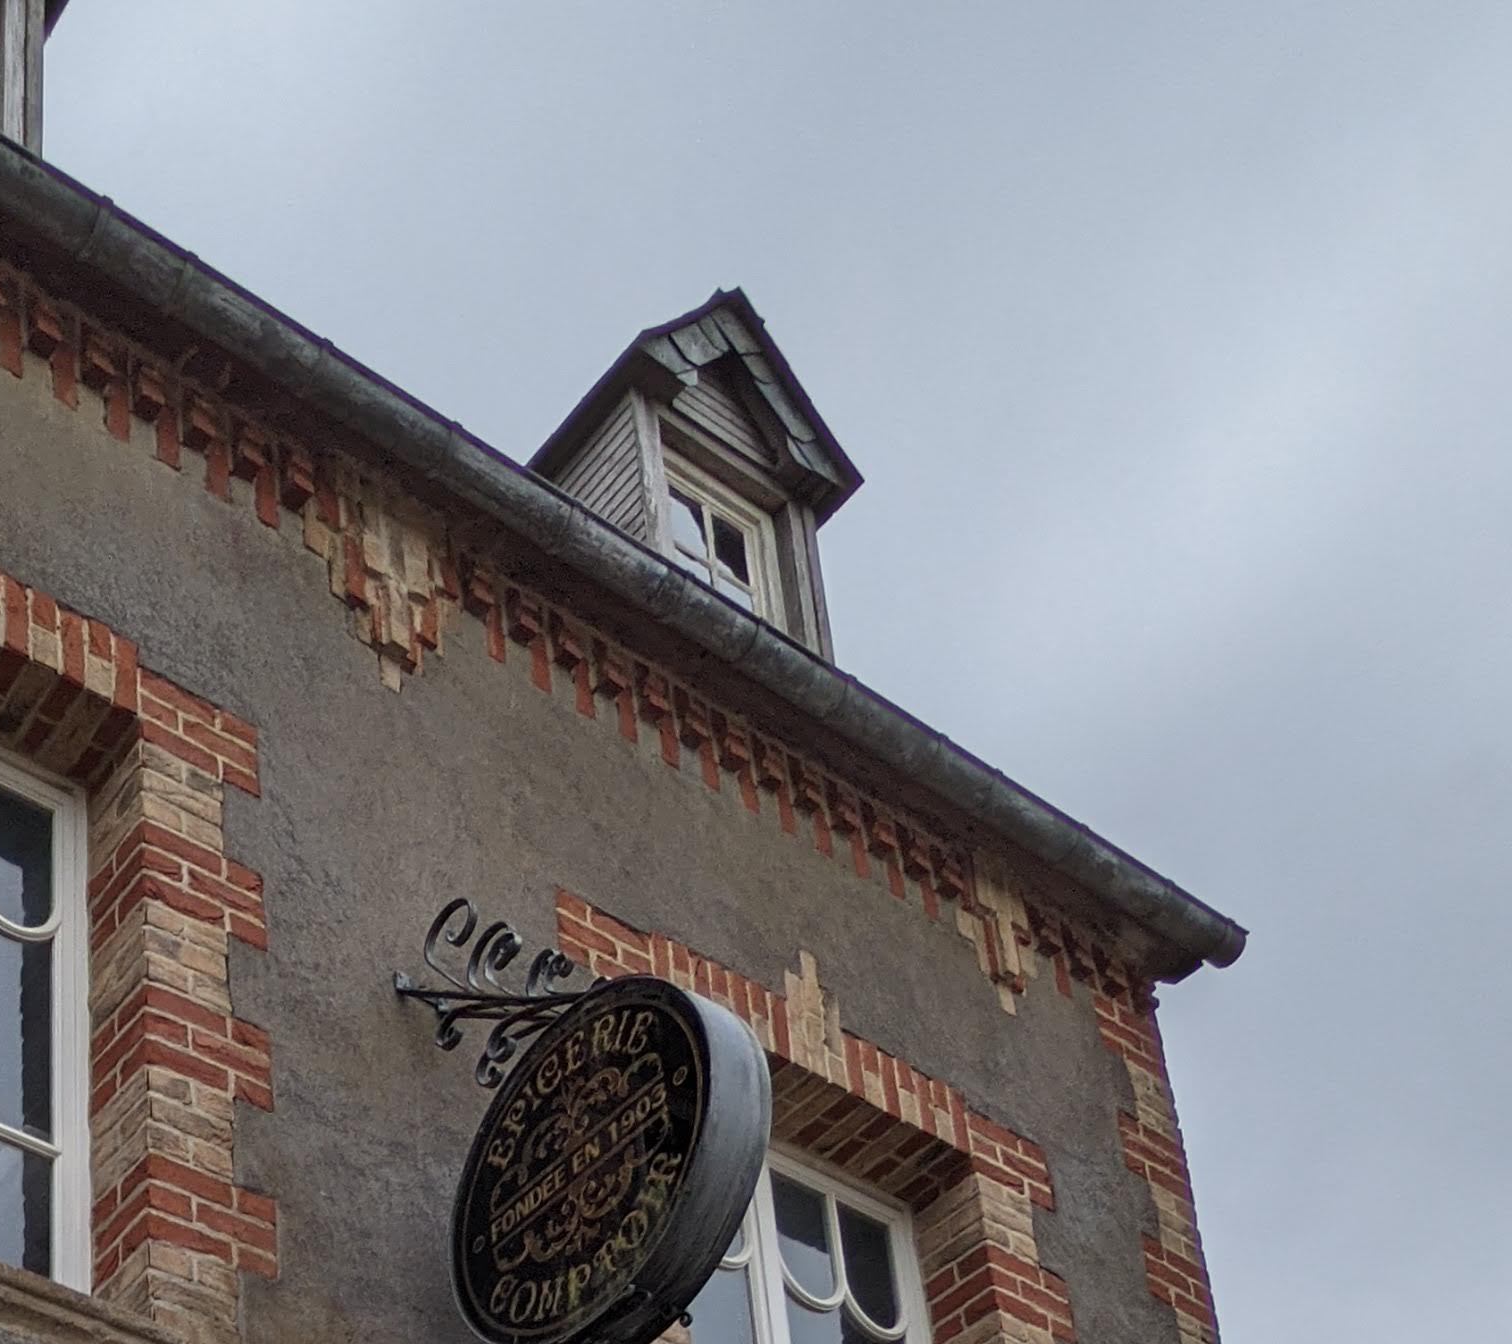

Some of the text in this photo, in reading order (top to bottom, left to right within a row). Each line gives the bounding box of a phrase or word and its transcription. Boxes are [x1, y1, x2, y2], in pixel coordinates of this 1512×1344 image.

[488, 1010, 654, 1170] EPICERIE
[571, 1144, 601, 1174] EN
[605, 1085, 668, 1143] 1903
[491, 1153, 683, 1323] COMPTOIR
